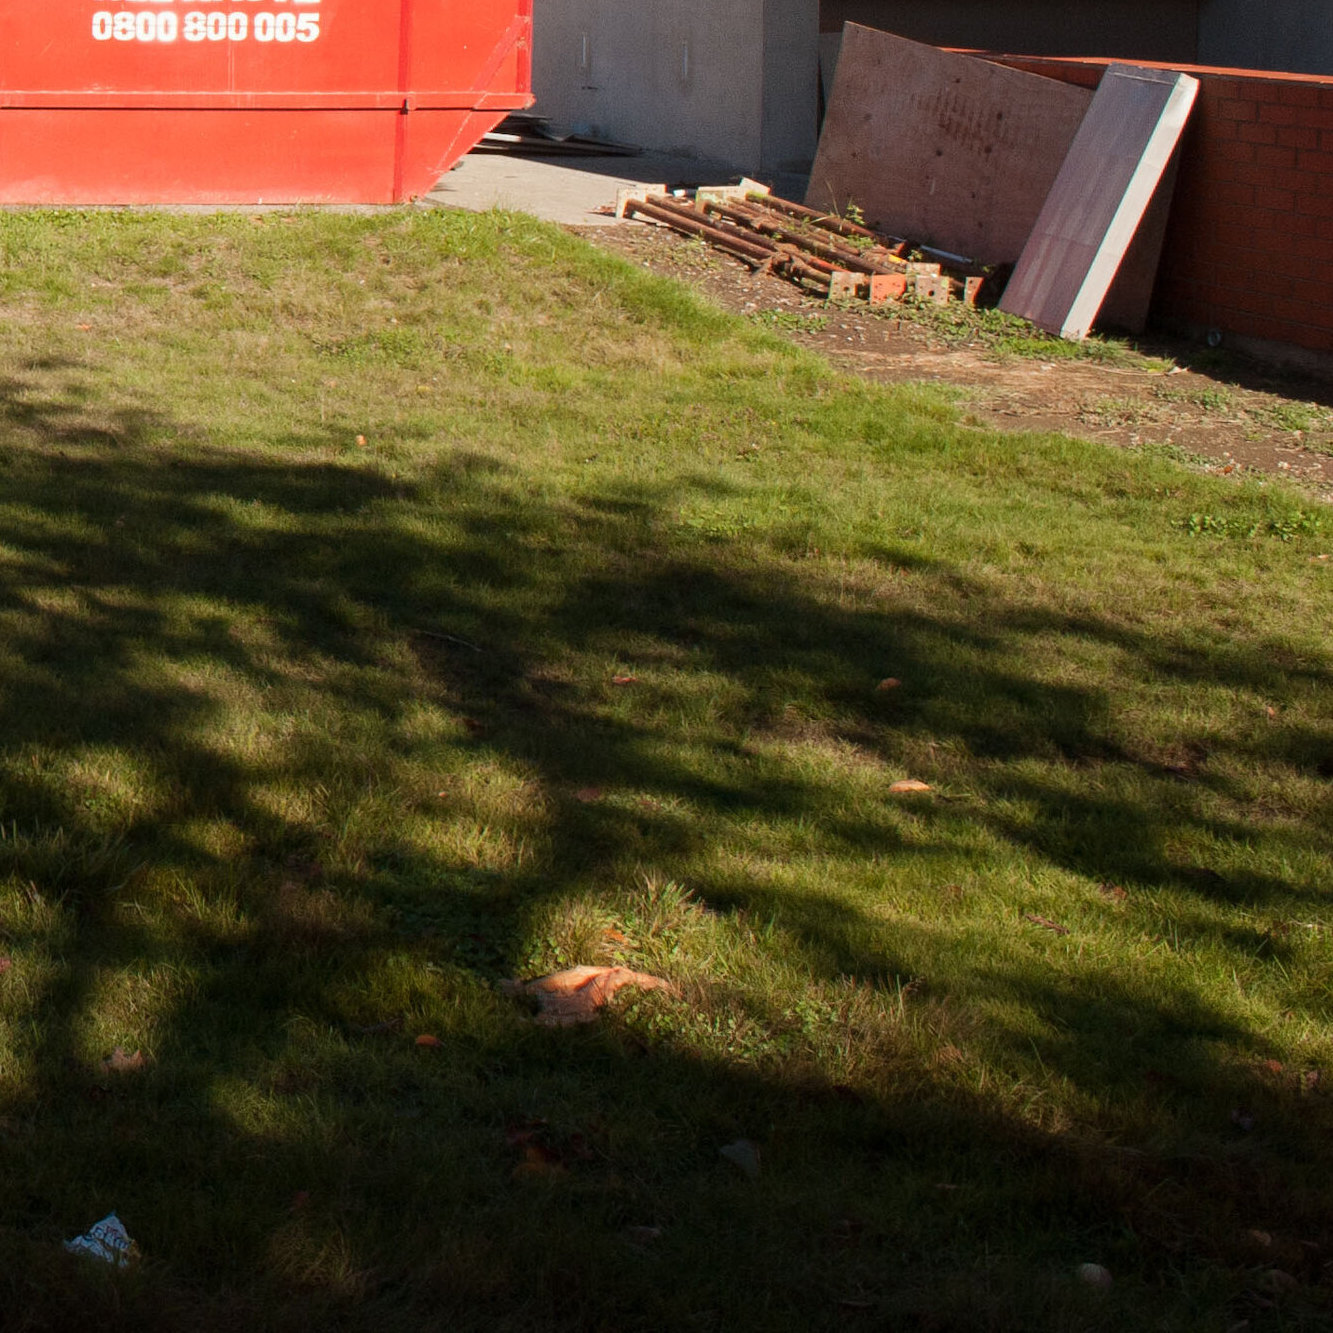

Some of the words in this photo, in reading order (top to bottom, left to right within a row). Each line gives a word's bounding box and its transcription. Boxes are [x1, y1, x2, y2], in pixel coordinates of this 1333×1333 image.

[91, 11, 177, 42] 0800
[183, 11, 248, 42] 800
[254, 11, 320, 43] 005
